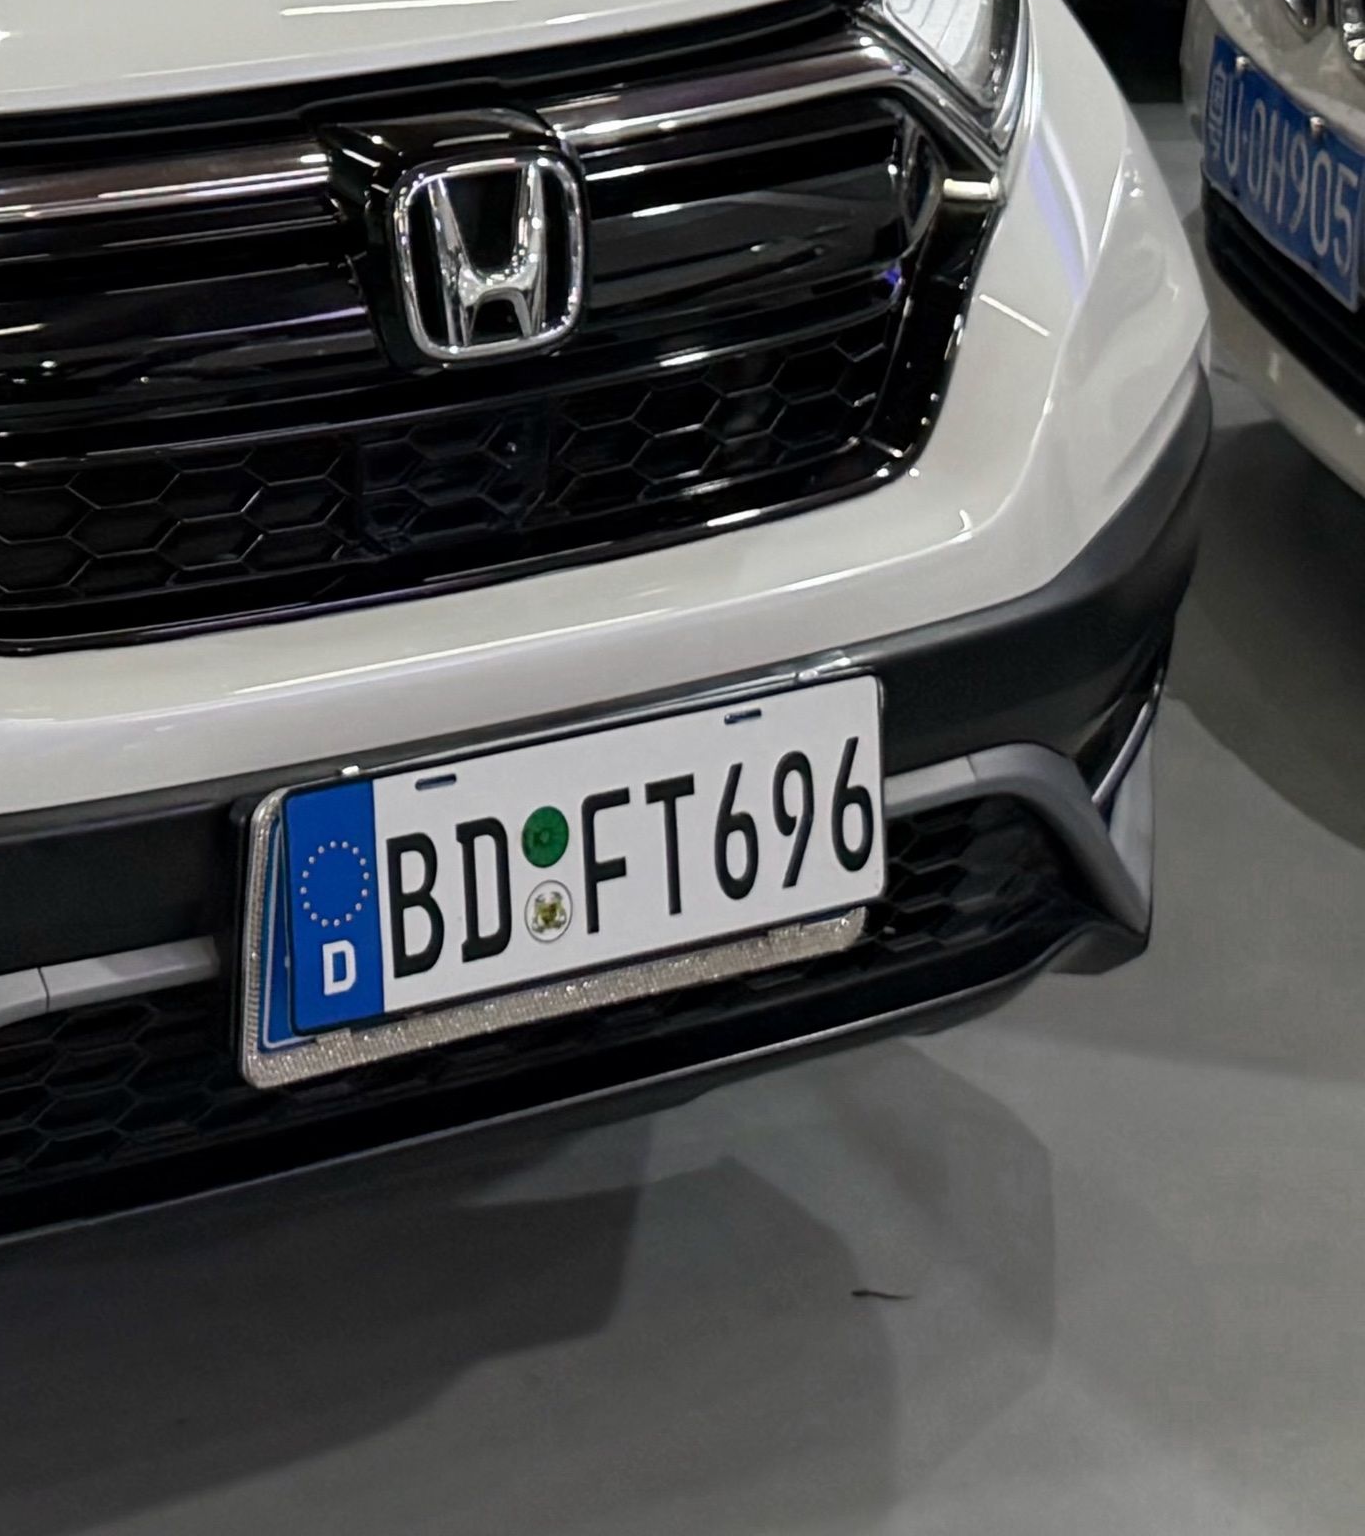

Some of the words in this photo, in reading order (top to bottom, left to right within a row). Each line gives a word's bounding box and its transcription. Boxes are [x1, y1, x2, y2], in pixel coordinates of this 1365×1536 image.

[386, 816, 512, 979] BD
[581, 736, 873, 934] FT696
[322, 939, 357, 996] D
